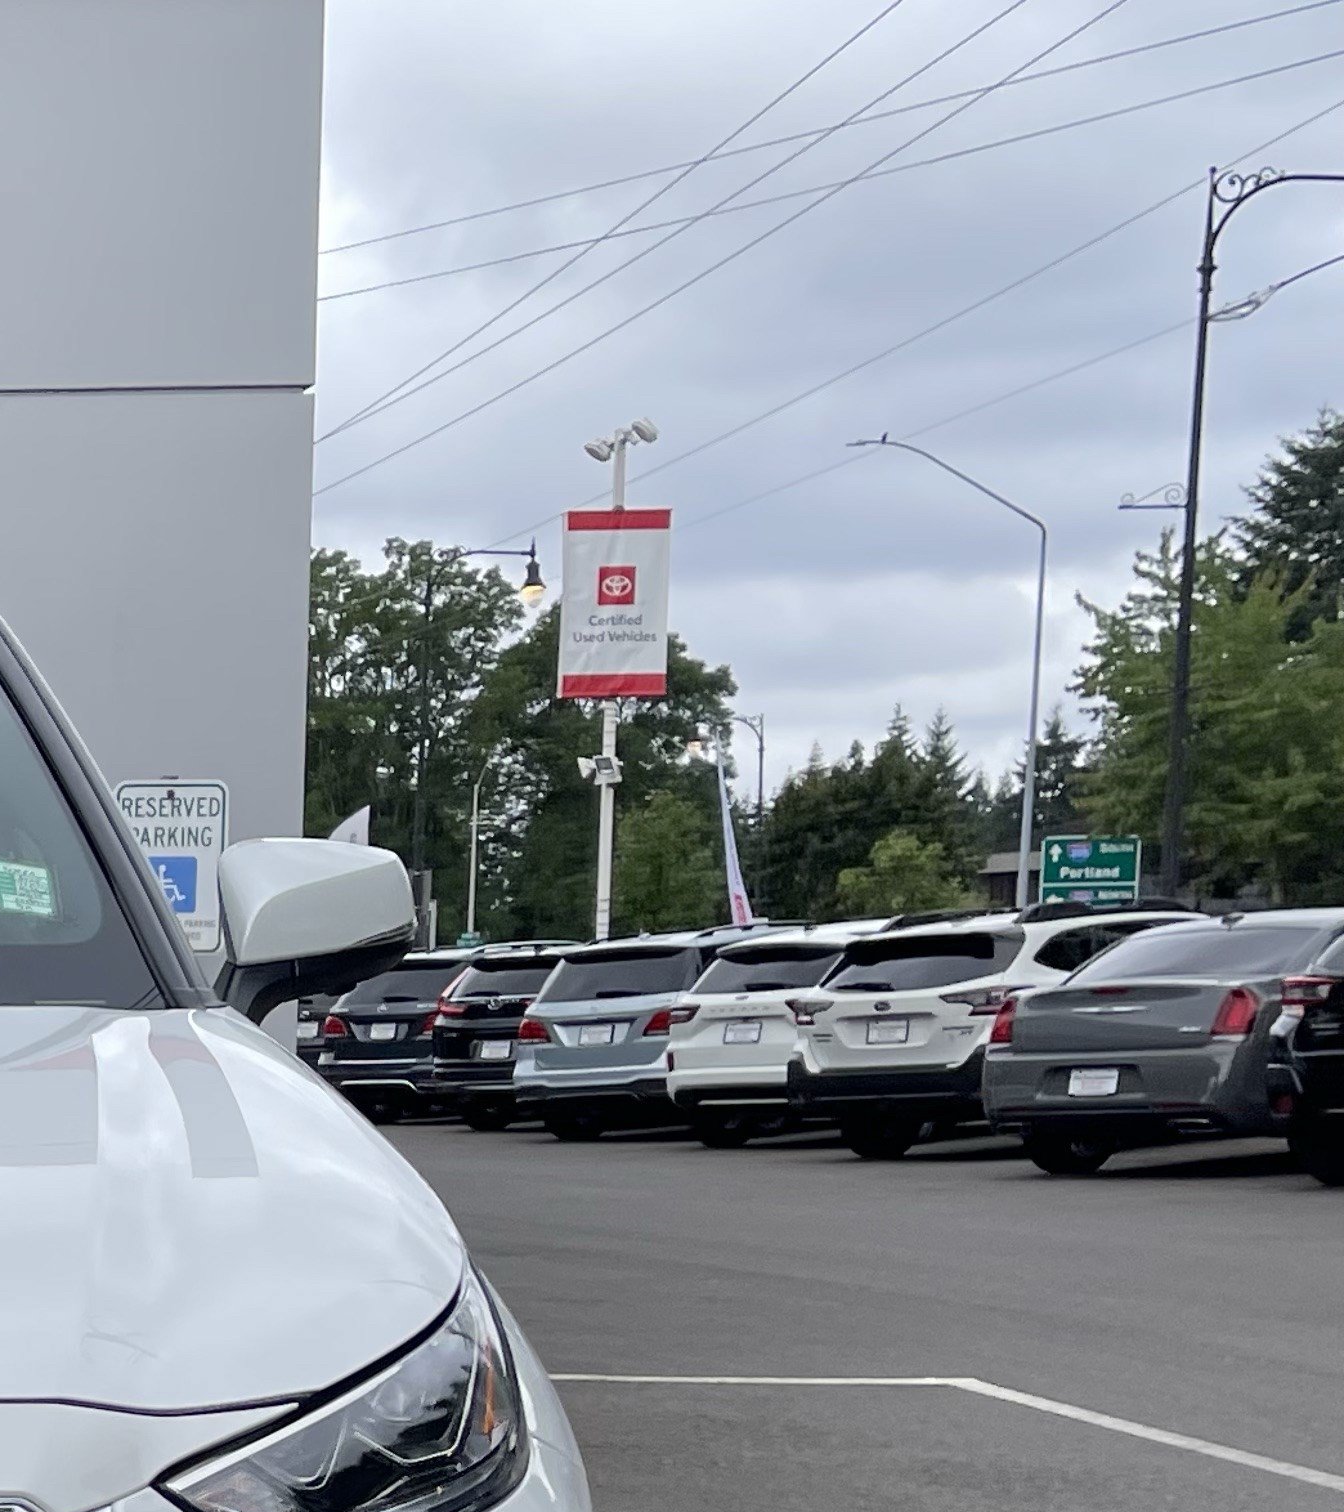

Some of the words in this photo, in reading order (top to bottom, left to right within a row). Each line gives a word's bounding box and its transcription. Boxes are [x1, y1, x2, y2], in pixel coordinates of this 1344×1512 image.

[589, 614, 642, 626] Certified
[573, 631, 605, 643] Used
[608, 630, 657, 642] Vehicles
[121, 797, 220, 818] RESERVED
[1060, 865, 1120, 878] Portland
